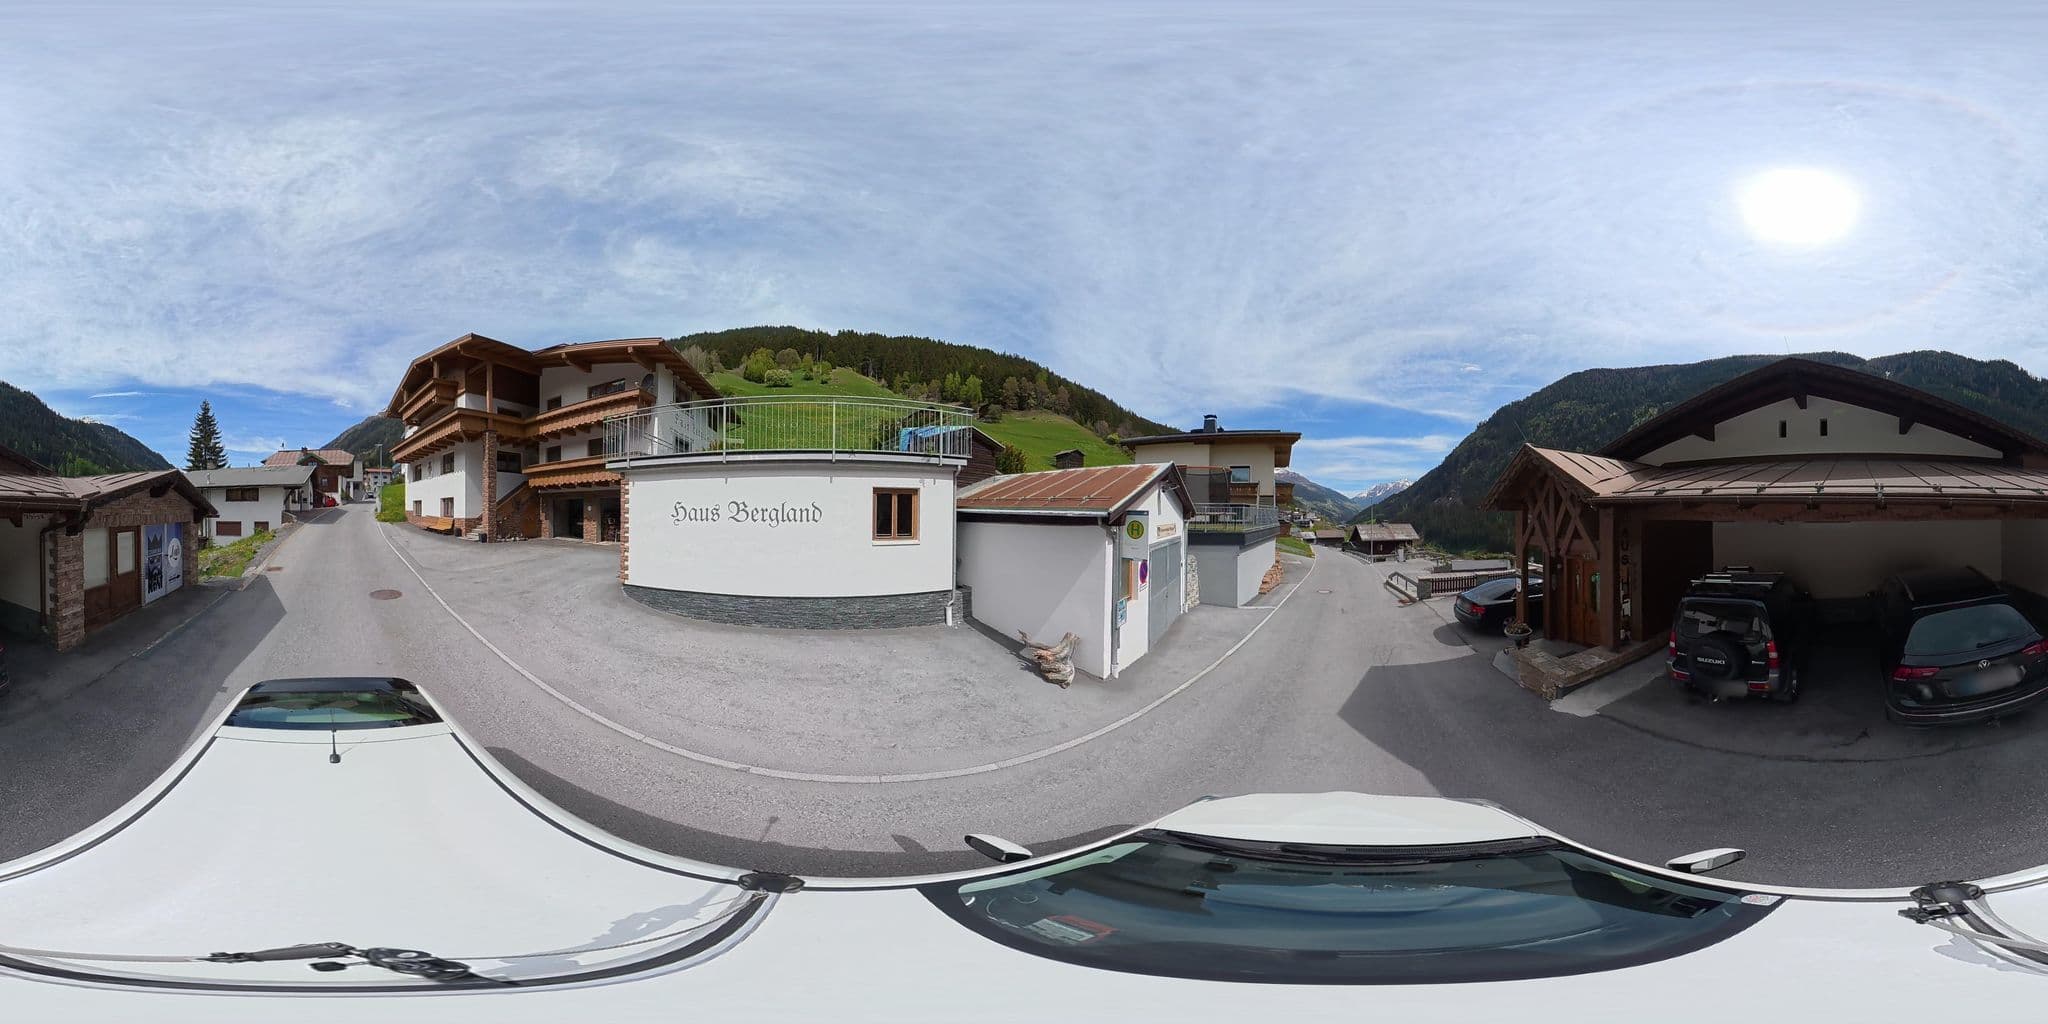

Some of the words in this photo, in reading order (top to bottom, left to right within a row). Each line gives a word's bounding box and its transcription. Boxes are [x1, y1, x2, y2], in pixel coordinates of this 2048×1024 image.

[671, 501, 721, 526] Haus
[727, 500, 823, 528] Bergland
[1131, 522, 1140, 537] H
[1696, 656, 1726, 665] SUZUKI
